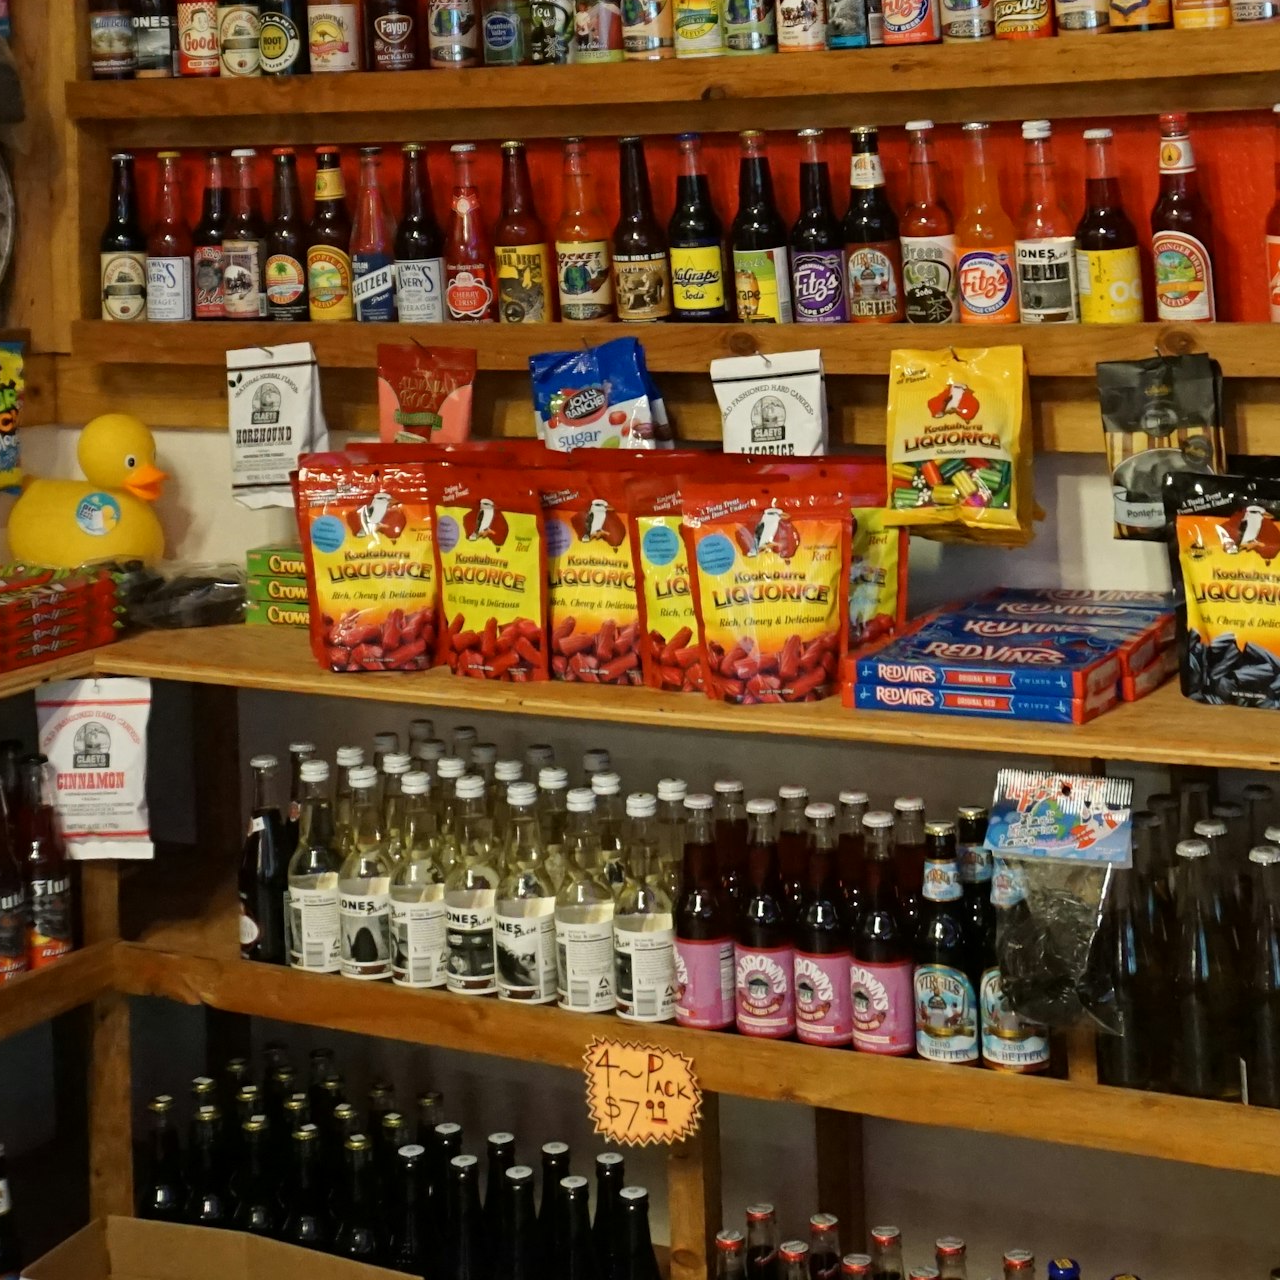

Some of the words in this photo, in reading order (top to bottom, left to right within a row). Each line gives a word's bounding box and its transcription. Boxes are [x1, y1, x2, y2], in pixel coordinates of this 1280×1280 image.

[380, 20, 409, 34] Faygo
[352, 272, 392, 297] SELTZER
[672, 266, 721, 286] NuGrape
[795, 271, 838, 298] Fitz's
[961, 269, 1009, 298] Fitz's
[451, 290, 479, 300] CHERRY
[566, 389, 596, 409] JOLLY
[235, 426, 293, 446] HOREHOUND
[903, 432, 1002, 453] LIQUORICE
[344, 550, 410, 560] Kookaburra
[327, 562, 432, 584] LIQUORICE
[443, 566, 526, 592] LIQUORICE
[712, 582, 830, 608] LIQUORICE
[56, 772, 126, 791] CINNAMON
